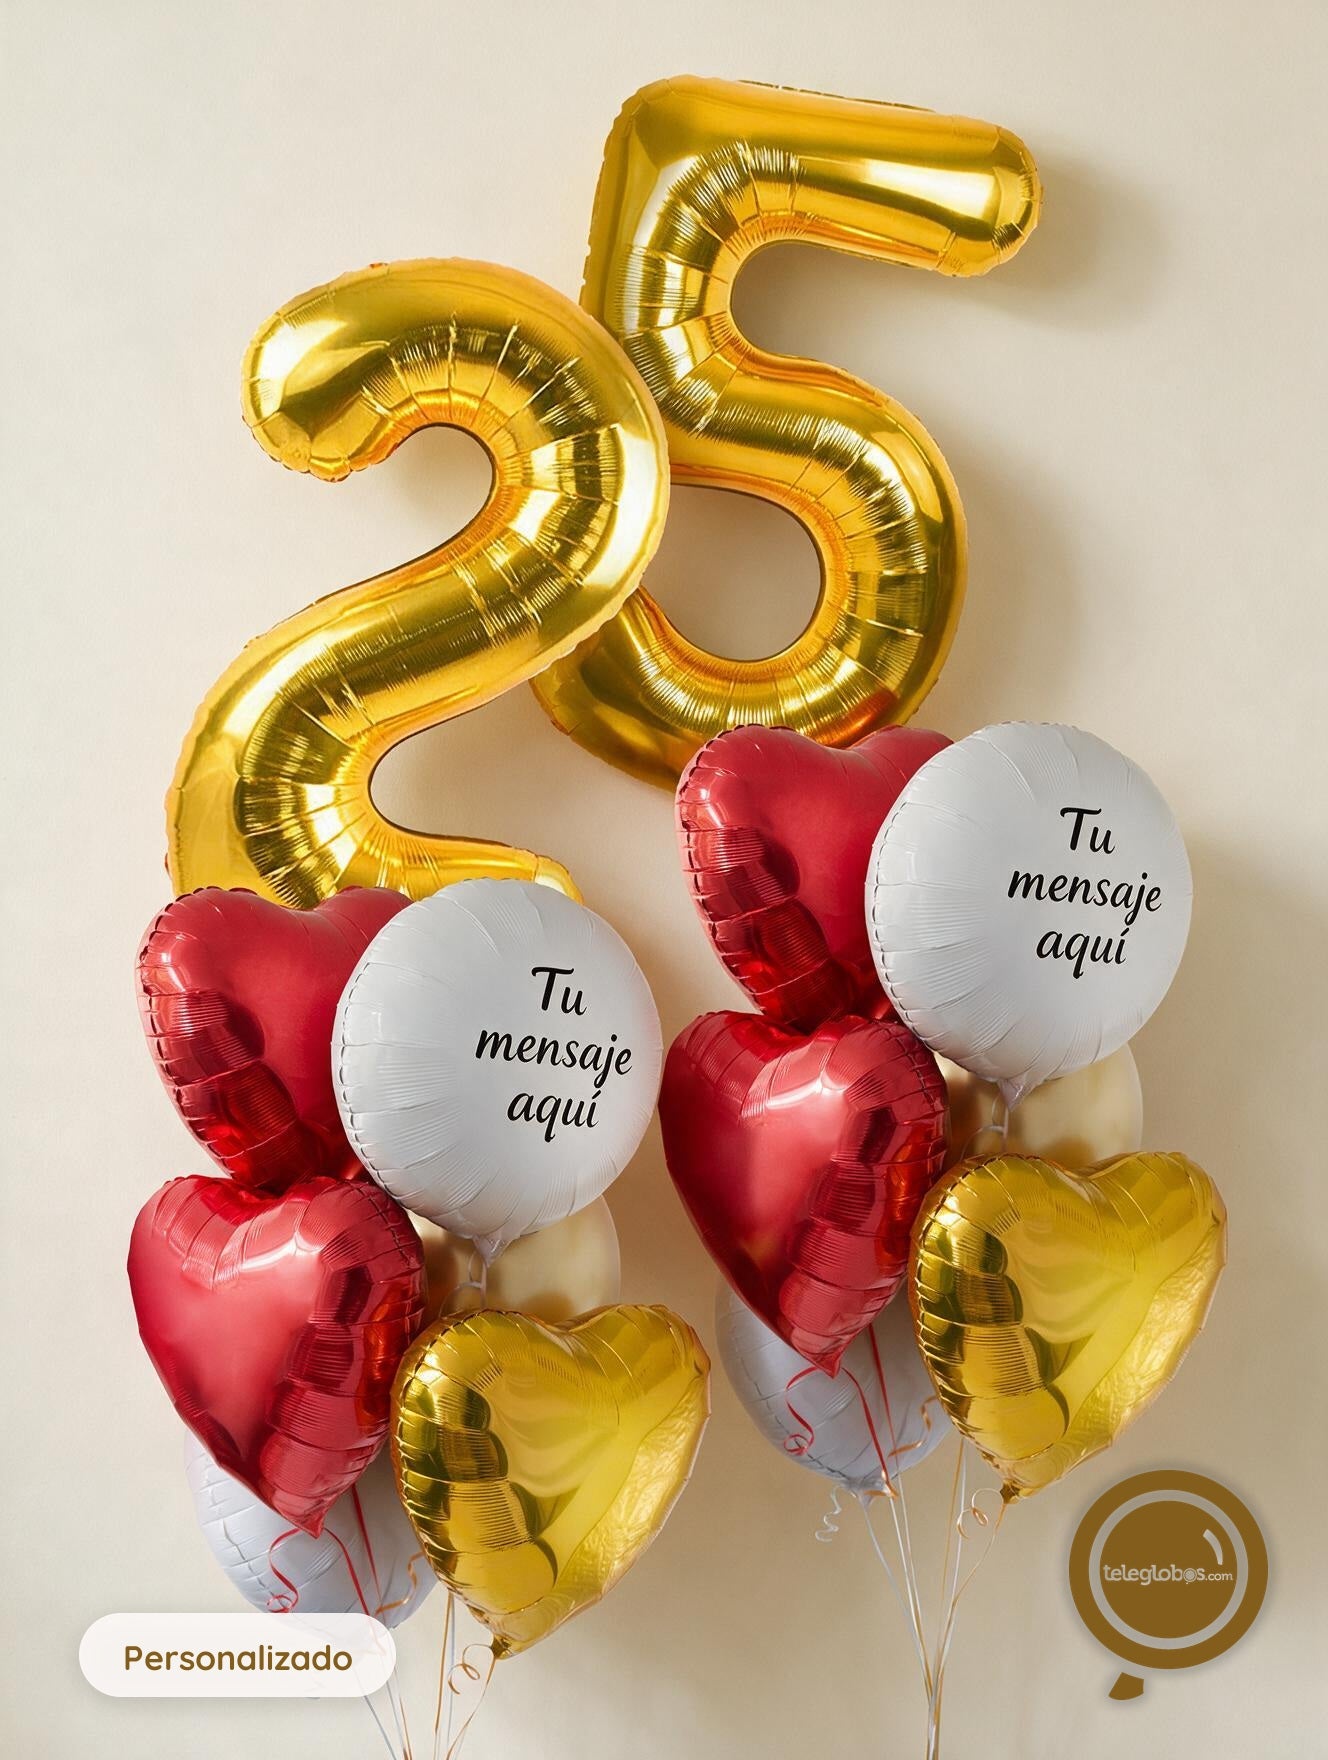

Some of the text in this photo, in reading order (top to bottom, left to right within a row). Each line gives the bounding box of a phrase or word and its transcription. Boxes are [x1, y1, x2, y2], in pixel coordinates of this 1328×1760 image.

[1059, 806, 1116, 855] Tu
[1007, 870, 1163, 928] mensaje
[1036, 927, 1130, 979] aquí
[531, 966, 588, 1016] Tu
[475, 1029, 633, 1089] mensaje
[507, 1089, 602, 1143] aquí
